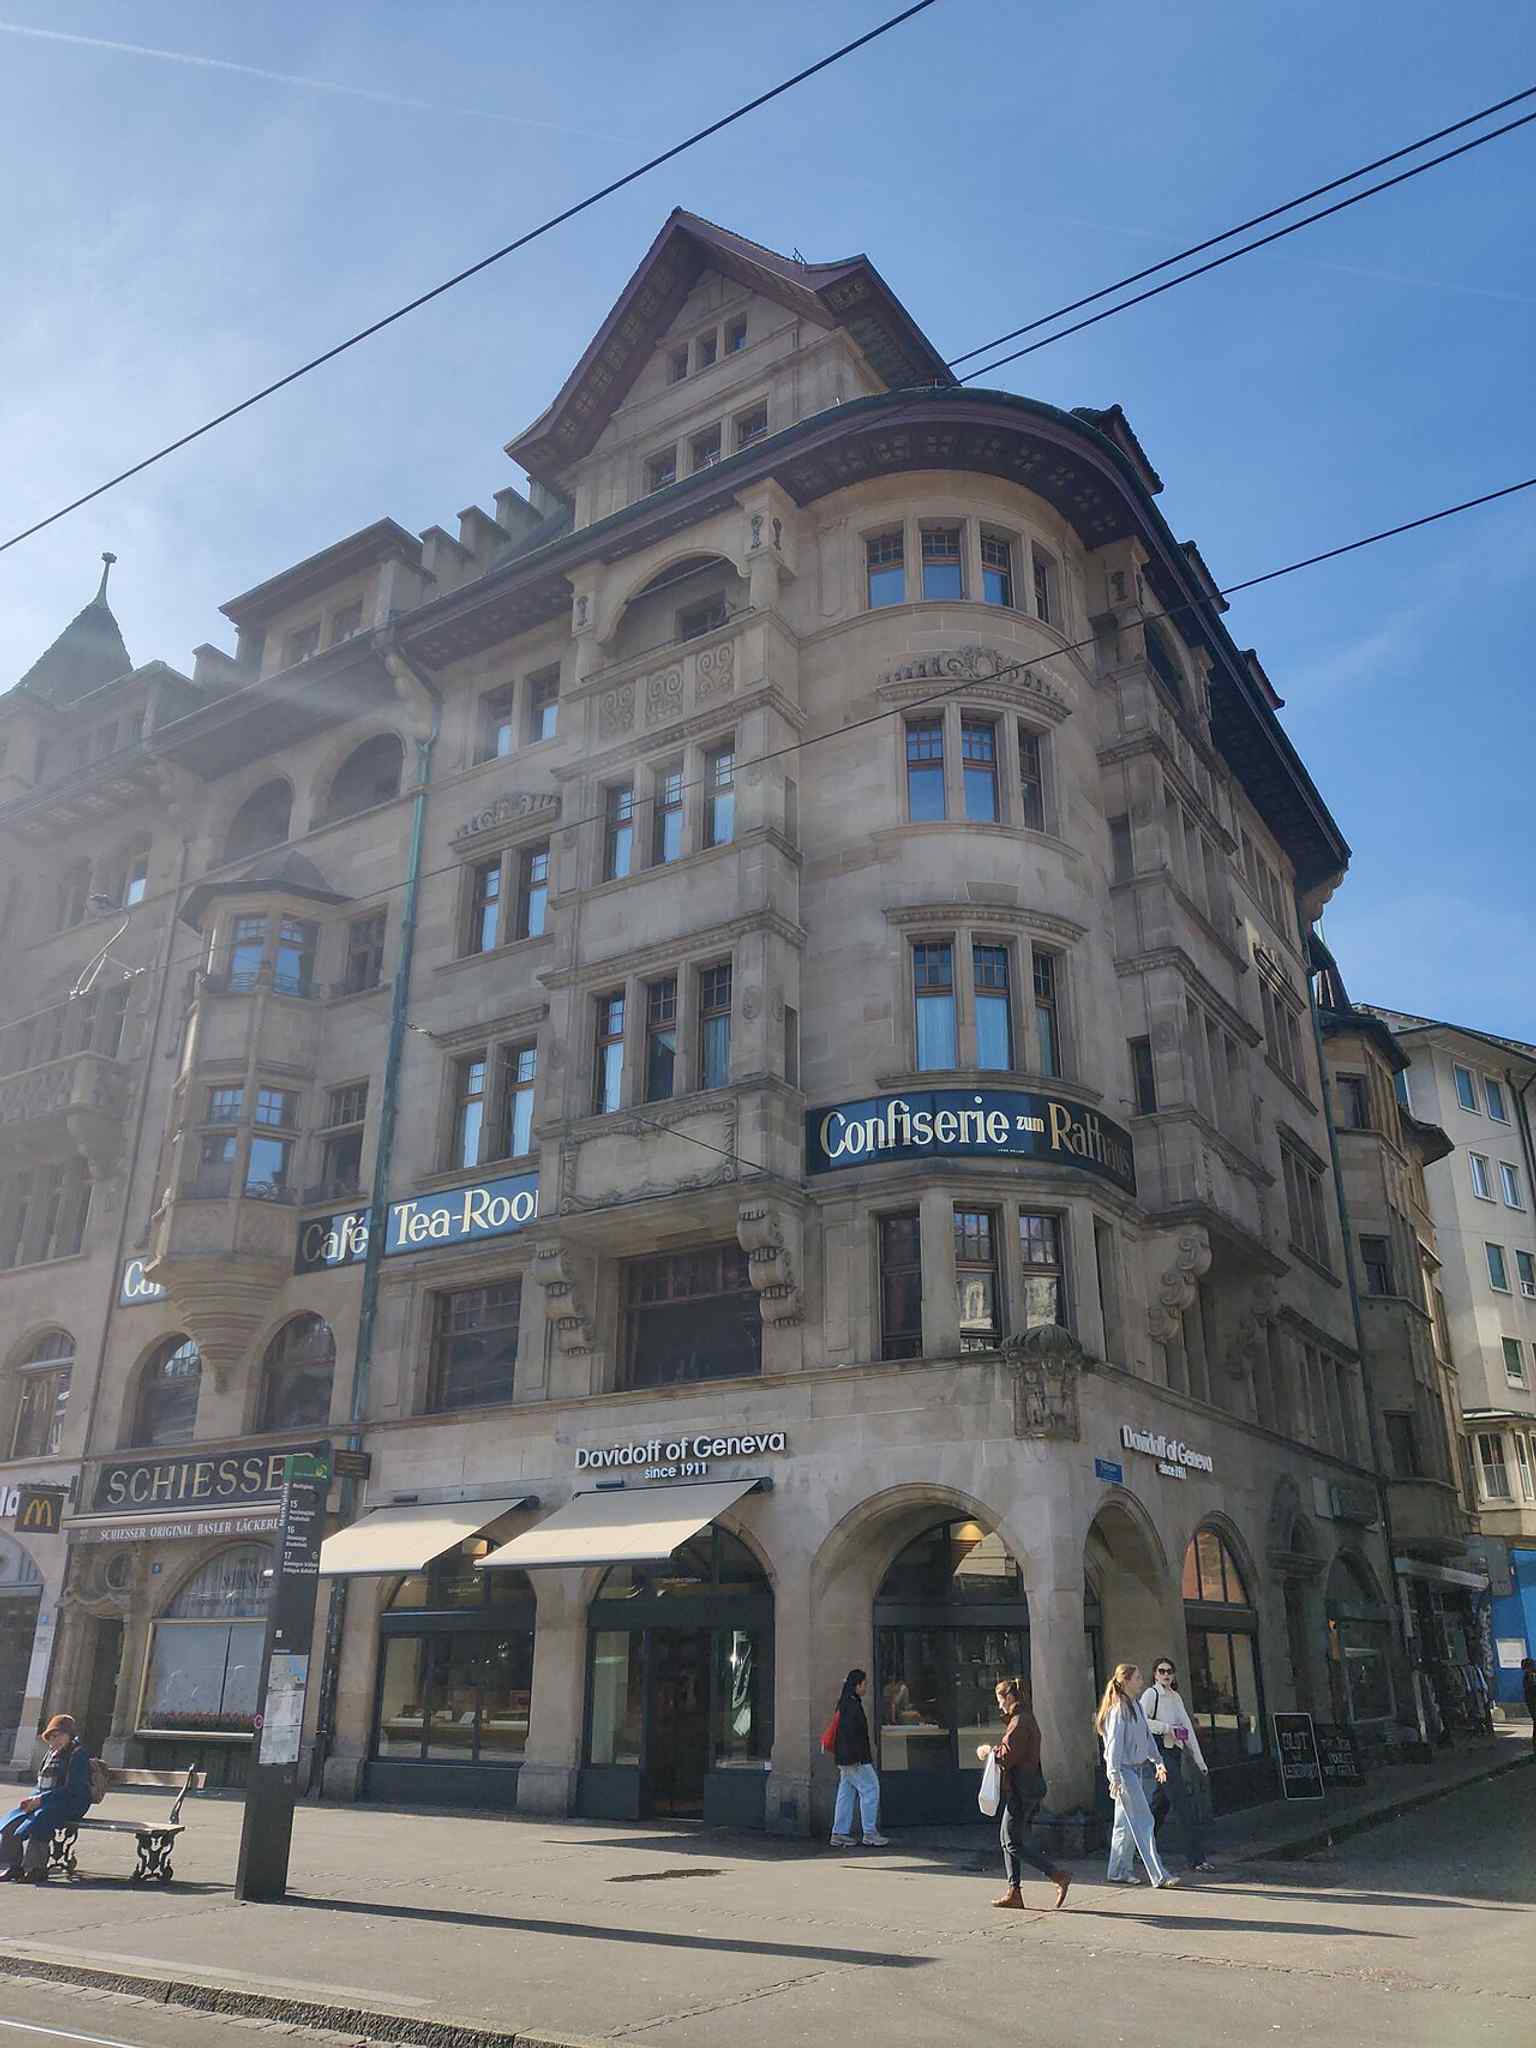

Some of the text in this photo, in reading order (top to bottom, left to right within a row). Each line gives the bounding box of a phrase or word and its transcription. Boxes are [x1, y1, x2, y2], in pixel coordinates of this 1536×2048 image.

[820, 1095, 1010, 1158] Confiserie
[1016, 1115, 1044, 1133] zum
[394, 1188, 539, 1246] Tea-Roo
[303, 1215, 368, 1263] Café
[574, 1432, 785, 1469] Davidoff of Geneva
[1122, 1424, 1167, 1458] Davidoff
[107, 1452, 314, 1504] SCHIESSE
[645, 1462, 707, 1479] since 1911
[100, 1517, 279, 1541] SCHIESSER ORIGINAL BASLER LÄCKERL
